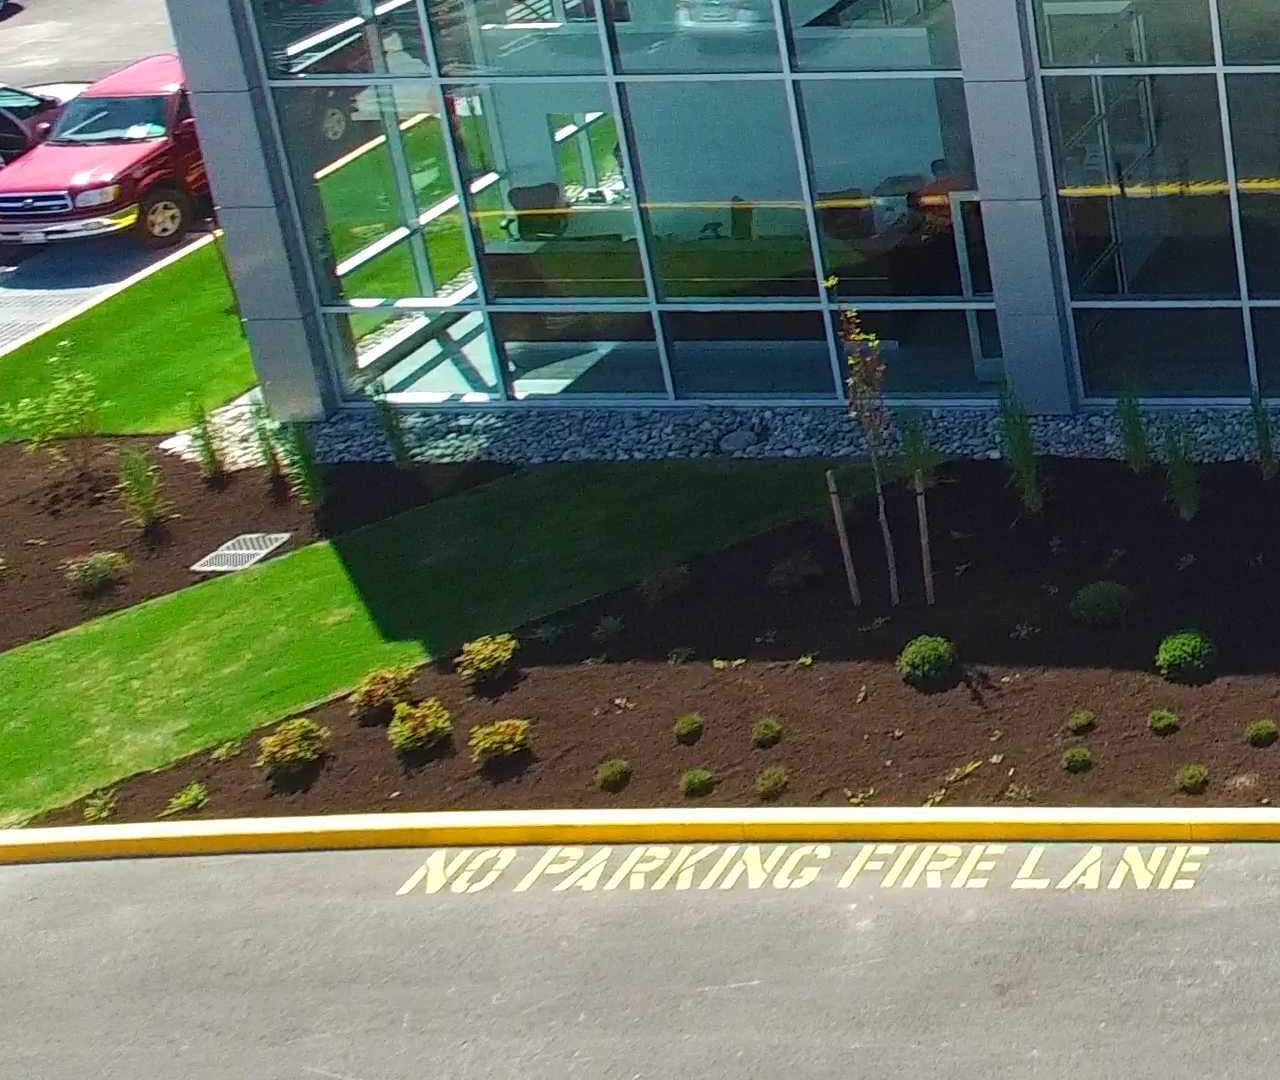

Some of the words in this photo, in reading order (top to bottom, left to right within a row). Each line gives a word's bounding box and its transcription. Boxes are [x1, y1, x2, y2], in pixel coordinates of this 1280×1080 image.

[395, 848, 517, 895] NO
[513, 845, 831, 892] PARKING
[837, 844, 1008, 888] FIRE
[1010, 846, 1210, 889] LANE
